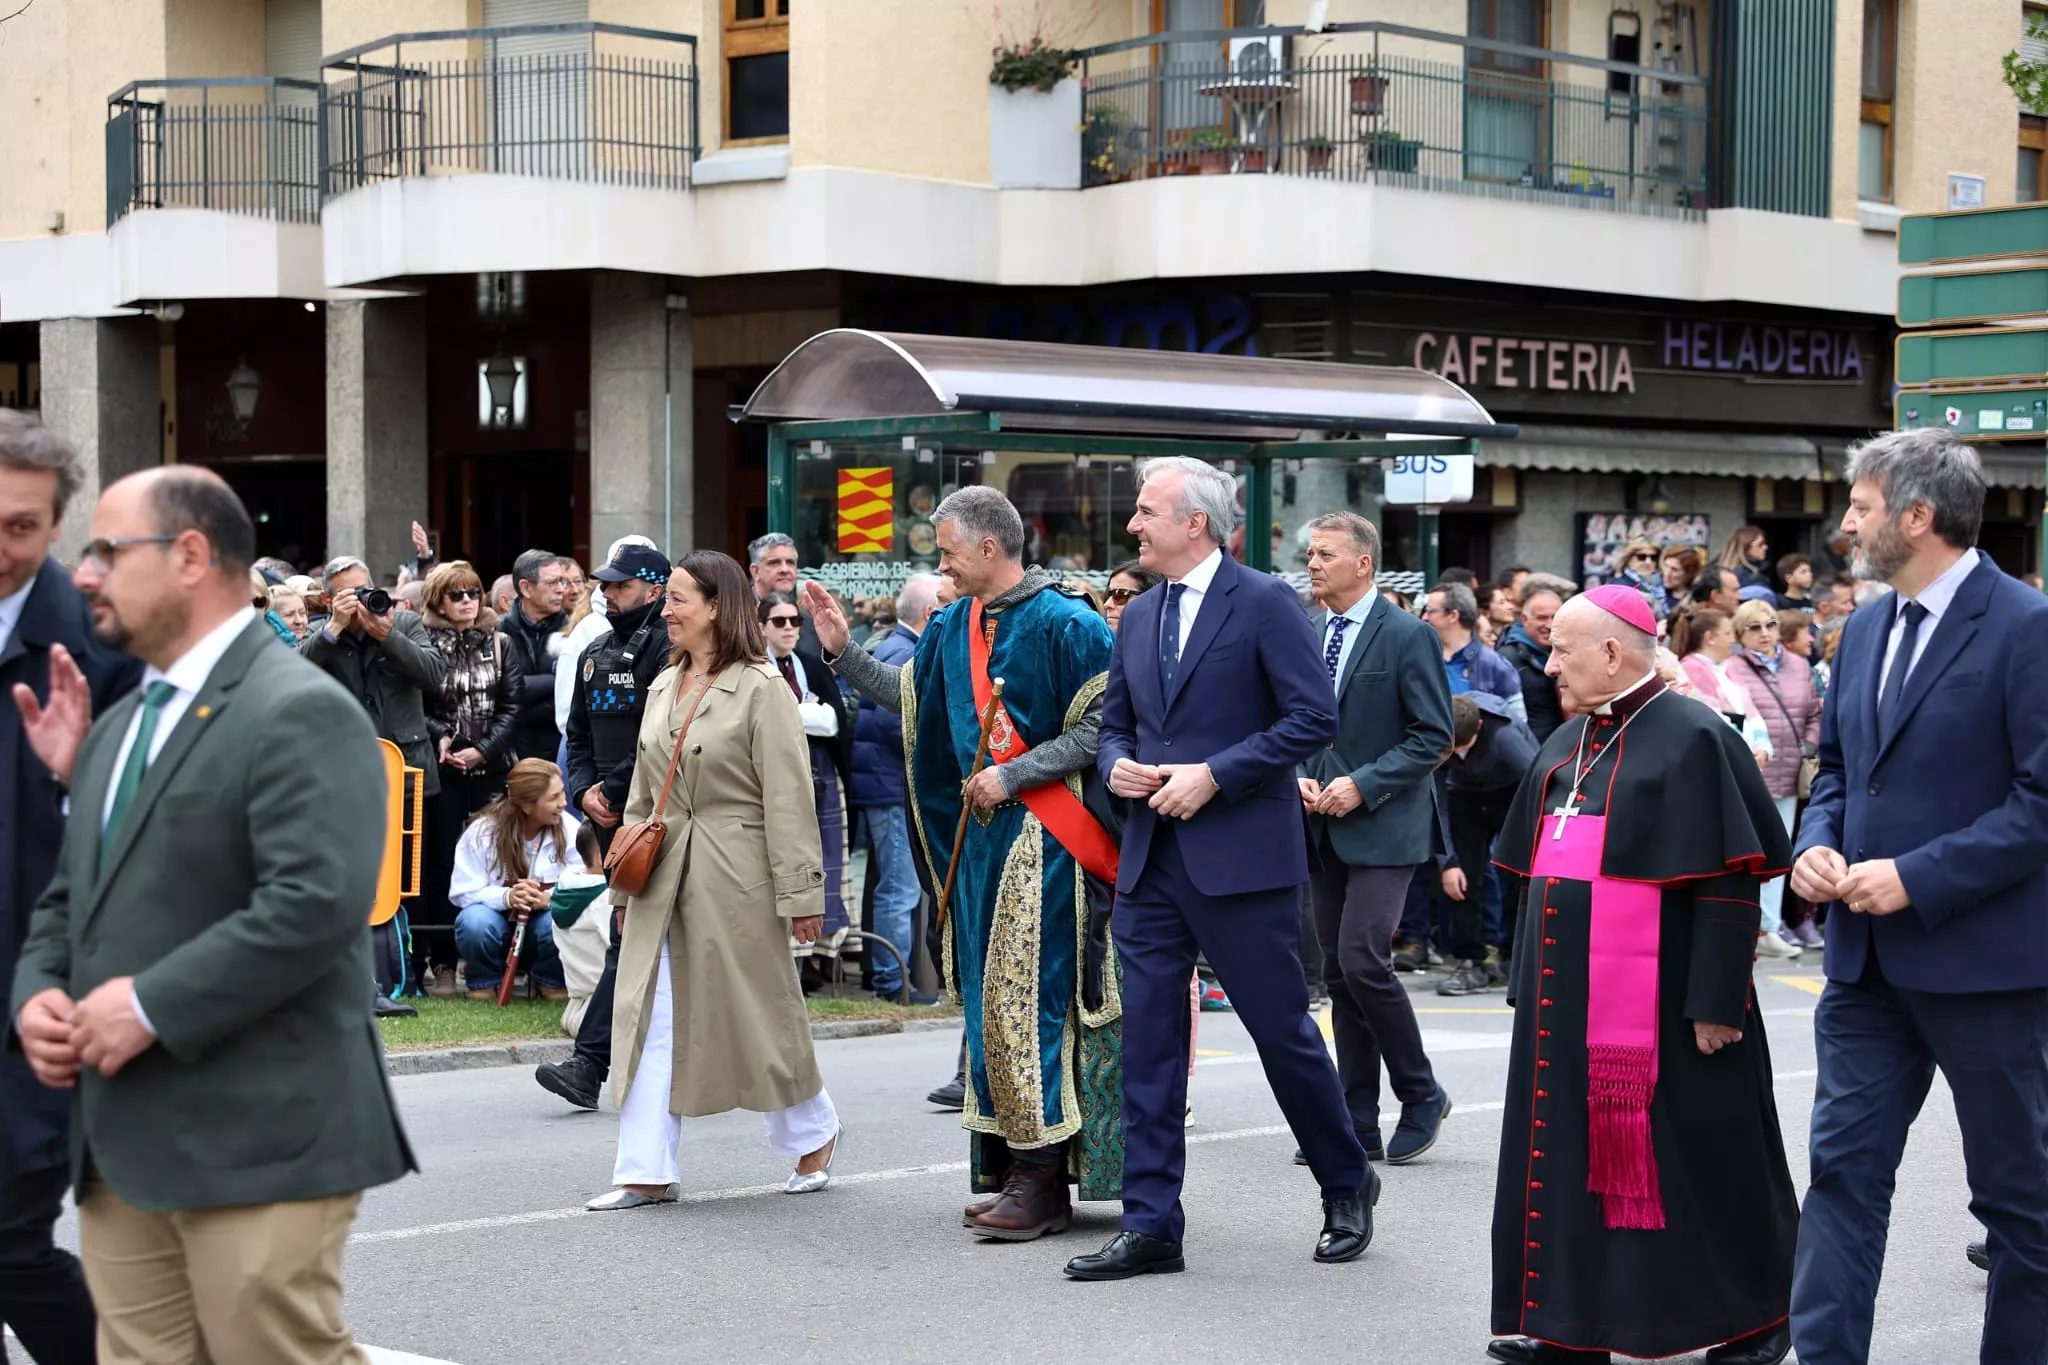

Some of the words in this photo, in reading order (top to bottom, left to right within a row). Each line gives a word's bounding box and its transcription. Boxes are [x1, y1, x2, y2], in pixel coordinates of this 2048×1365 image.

[1413, 332, 1637, 394] CAFETERIA
[1664, 320, 1864, 379] HELADERIA
[821, 561, 887, 579] GOBIERNO
[892, 560, 911, 578] DE
